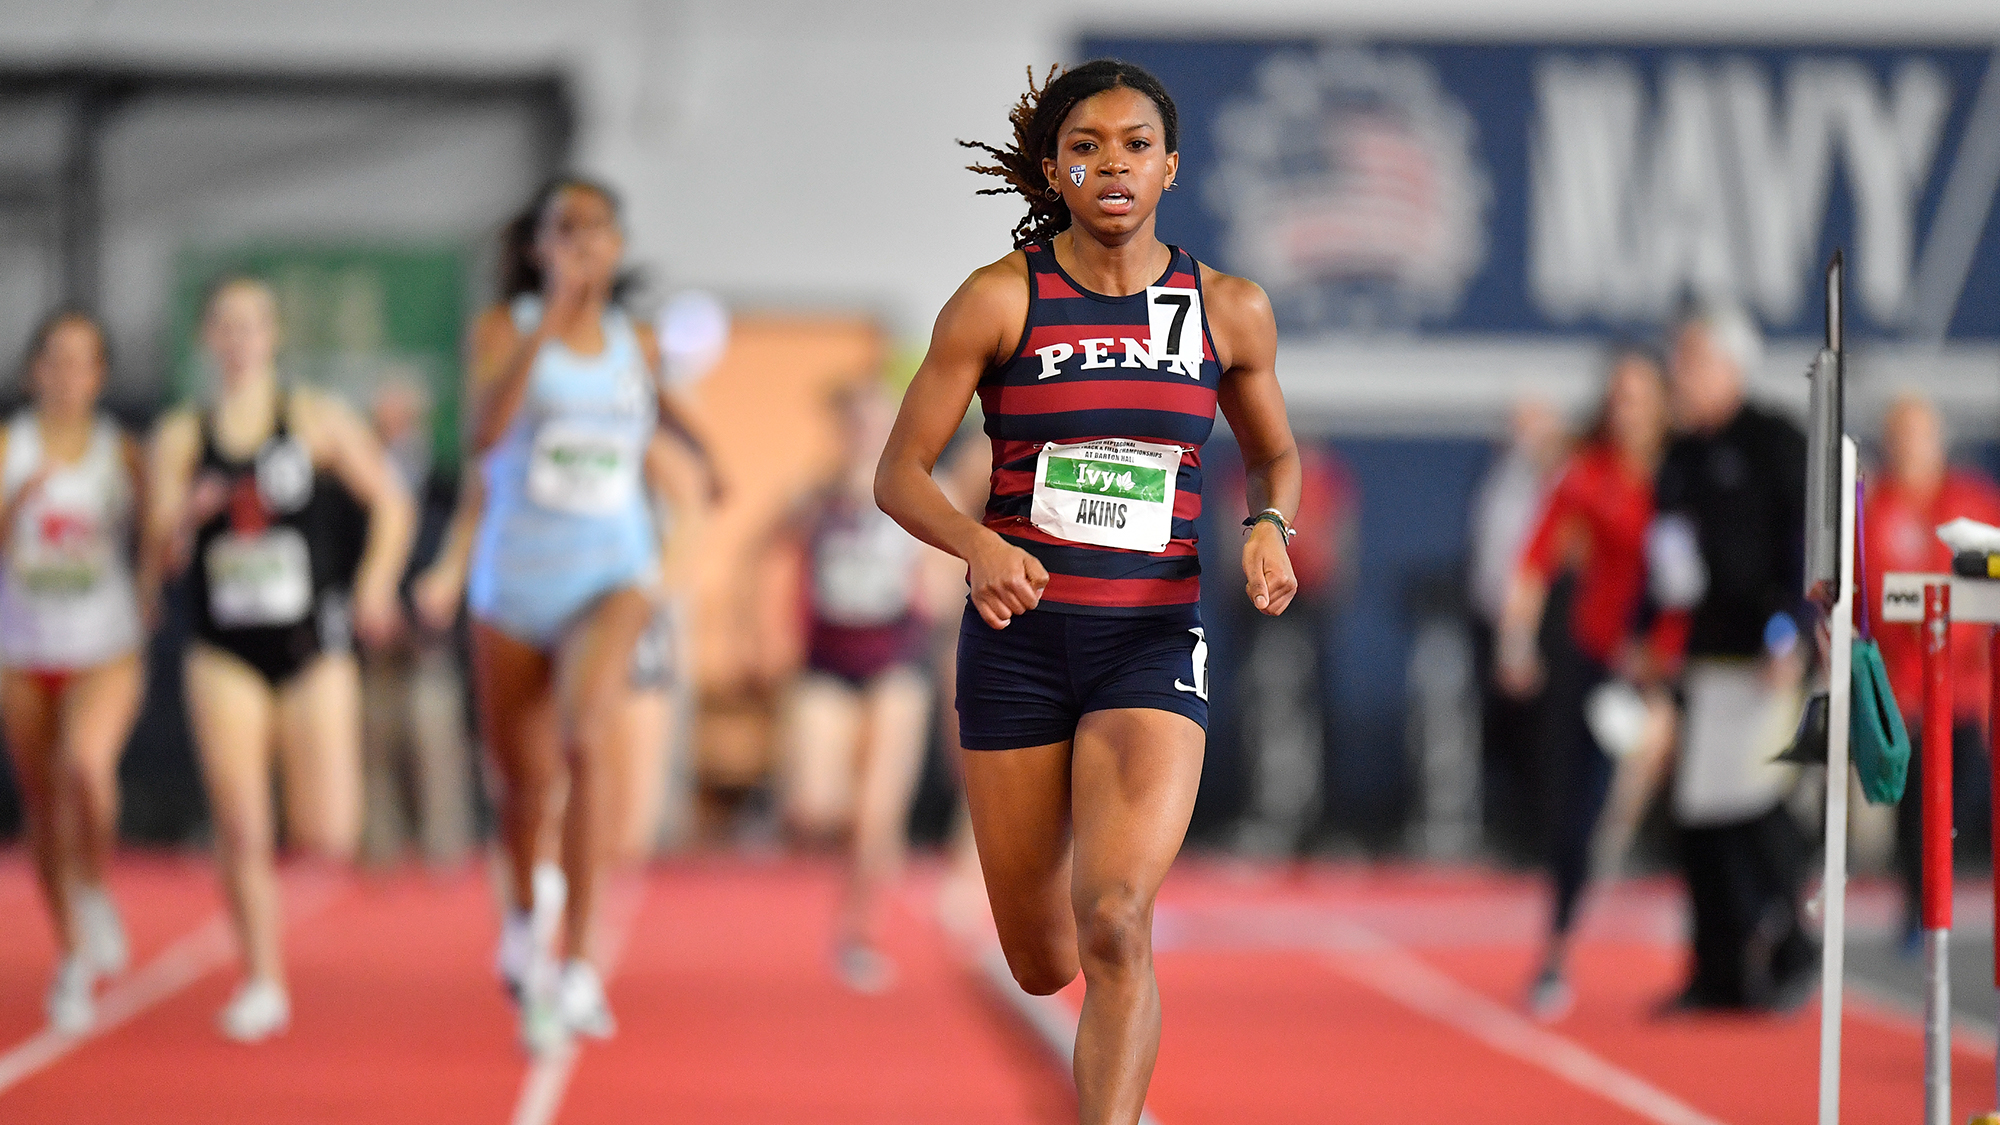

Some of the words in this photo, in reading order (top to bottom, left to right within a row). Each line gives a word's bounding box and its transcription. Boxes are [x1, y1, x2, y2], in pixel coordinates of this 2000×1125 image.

[1532, 57, 1951, 323] NAVY
[1154, 294, 1191, 355] 7
[1094, 452, 1119, 461] BARTON
[1076, 463, 1116, 492] Ivy
[1076, 498, 1128, 529] AKINS
